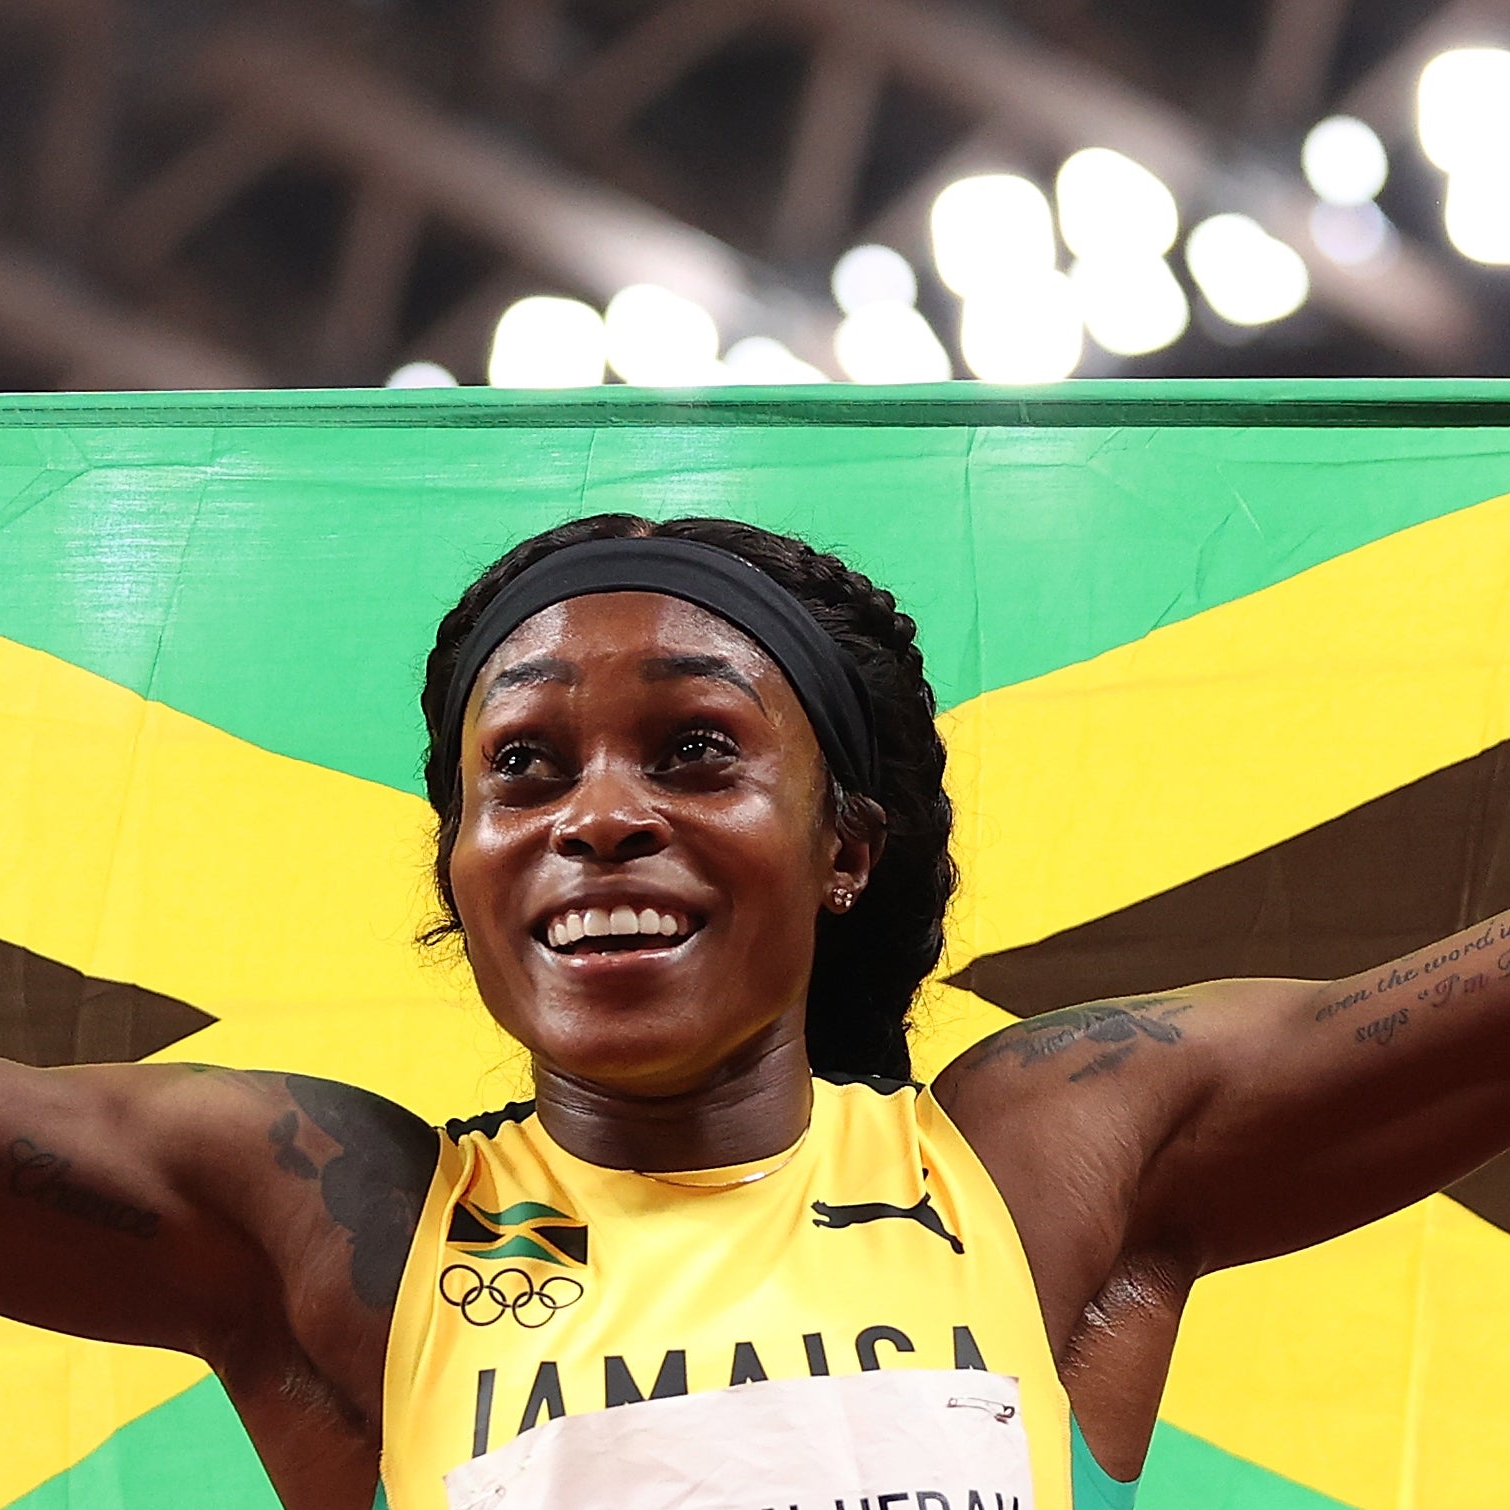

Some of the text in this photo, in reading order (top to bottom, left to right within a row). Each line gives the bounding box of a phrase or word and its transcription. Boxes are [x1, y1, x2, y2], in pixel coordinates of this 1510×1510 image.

[1315, 989, 1371, 1022] even
[1377, 967, 1419, 993] the
[1422, 923, 1494, 975] word
[1355, 1007, 1410, 1046] says
